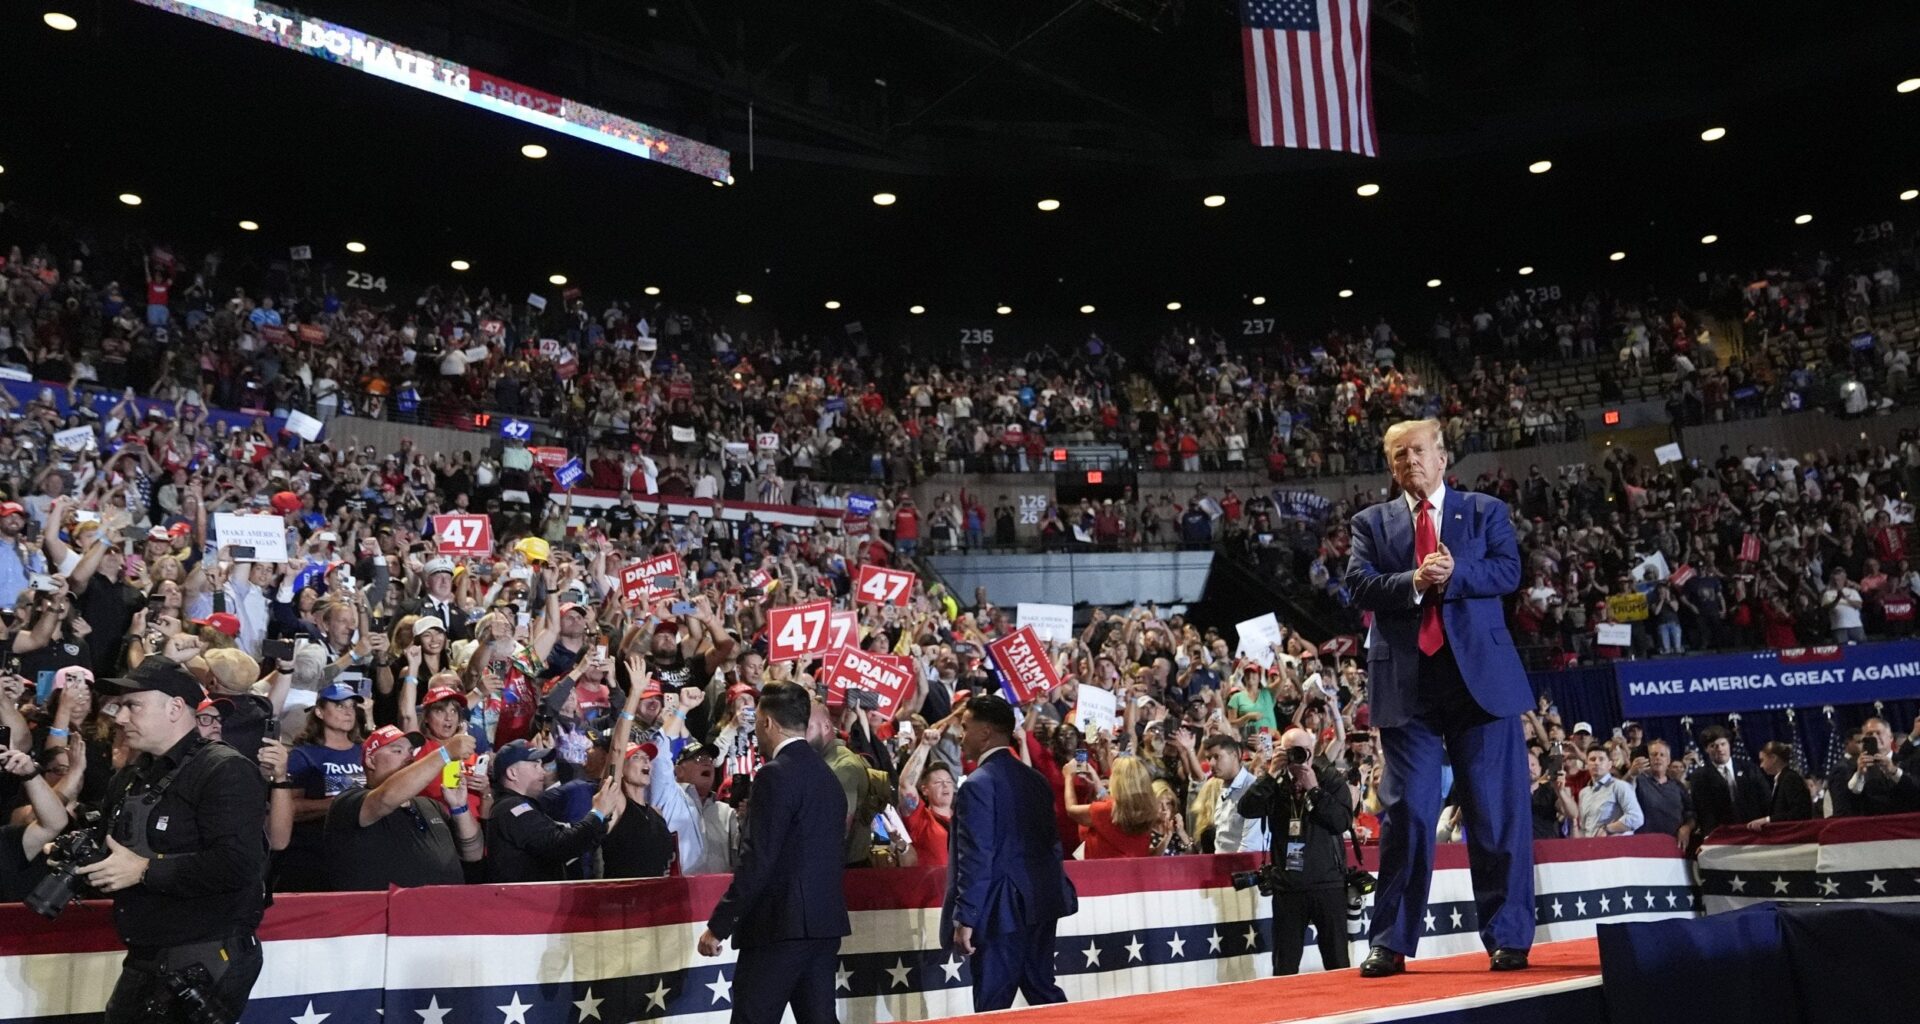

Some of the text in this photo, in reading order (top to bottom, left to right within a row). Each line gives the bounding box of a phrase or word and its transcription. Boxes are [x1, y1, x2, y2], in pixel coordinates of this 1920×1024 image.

[301, 20, 434, 80] DONATE
[442, 67, 471, 91] TO
[1853, 221, 1895, 244] 239
[346, 270, 388, 293] 234
[960, 329, 994, 345] 236
[1243, 319, 1276, 336] 237
[541, 342, 557, 353] 47
[503, 422, 531, 437] 47
[758, 436, 776, 446] 47
[1019, 495, 1047, 509] 126
[1277, 490, 1331, 511] TRUMP
[1020, 511, 1039, 524] 26
[441, 519, 484, 547] 47
[625, 559, 673, 584] DRAIN
[862, 572, 909, 600] 47
[776, 609, 826, 652] 47
[829, 618, 851, 648] 7
[1322, 638, 1353, 655] 47
[843, 653, 903, 690] DRAIN
[1008, 645, 1038, 690] VANCE
[1013, 632, 1051, 690] TRUMP
[860, 675, 879, 690] THE
[1629, 661, 1920, 696] MAKE AMERICA GREAT AGAIN!
